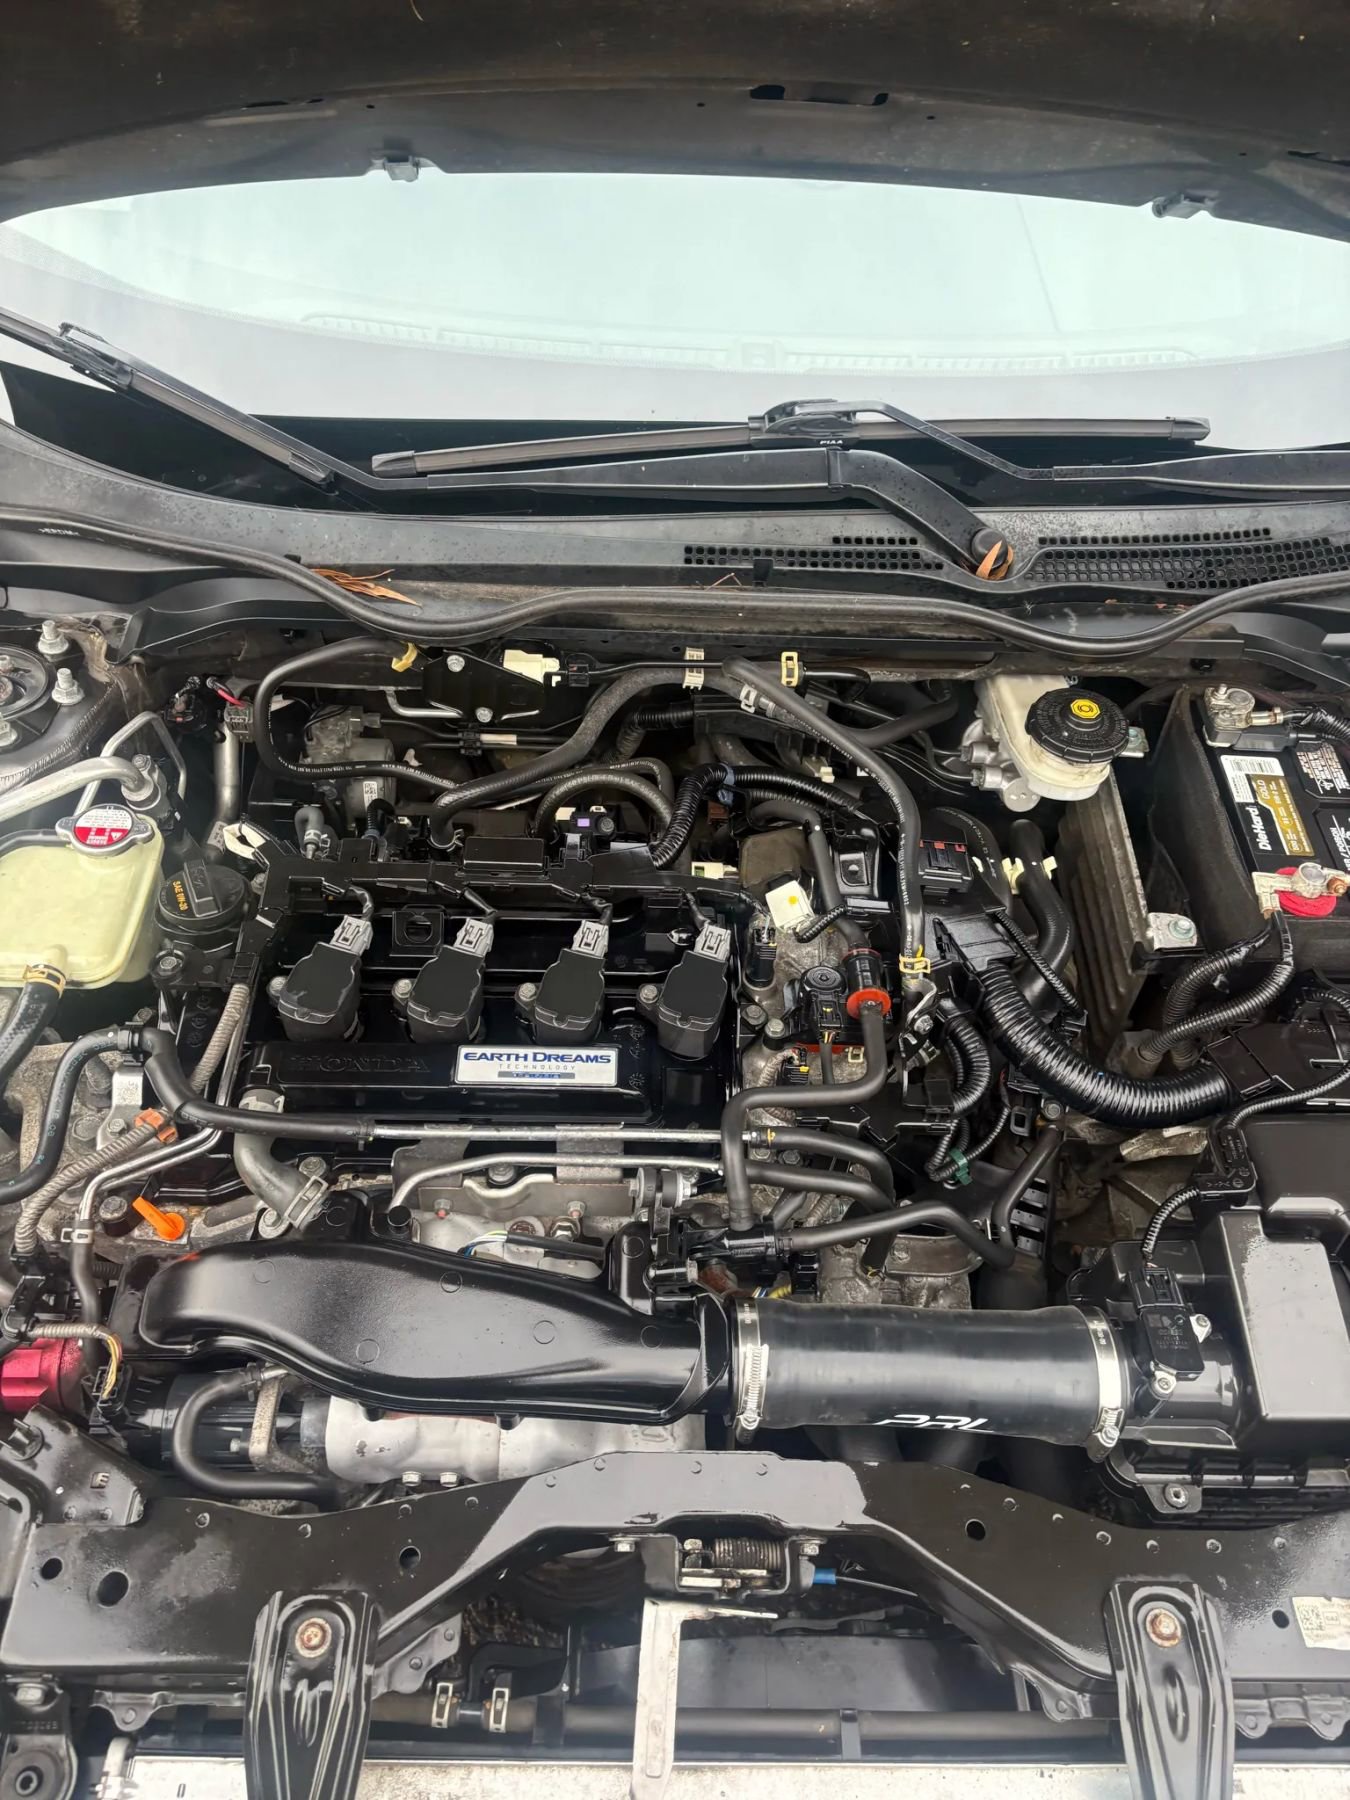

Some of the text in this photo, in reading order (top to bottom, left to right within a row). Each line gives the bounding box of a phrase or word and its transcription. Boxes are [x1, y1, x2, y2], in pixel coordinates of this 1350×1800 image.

[1257, 779, 1270, 800] GOLD
[1245, 806, 1272, 851] DieHard
[173, 881, 183, 893] SAE
[290, 1055, 431, 1073] HONDA
[463, 1052, 528, 1062] EARTH
[872, 1414, 995, 1432] PRL
